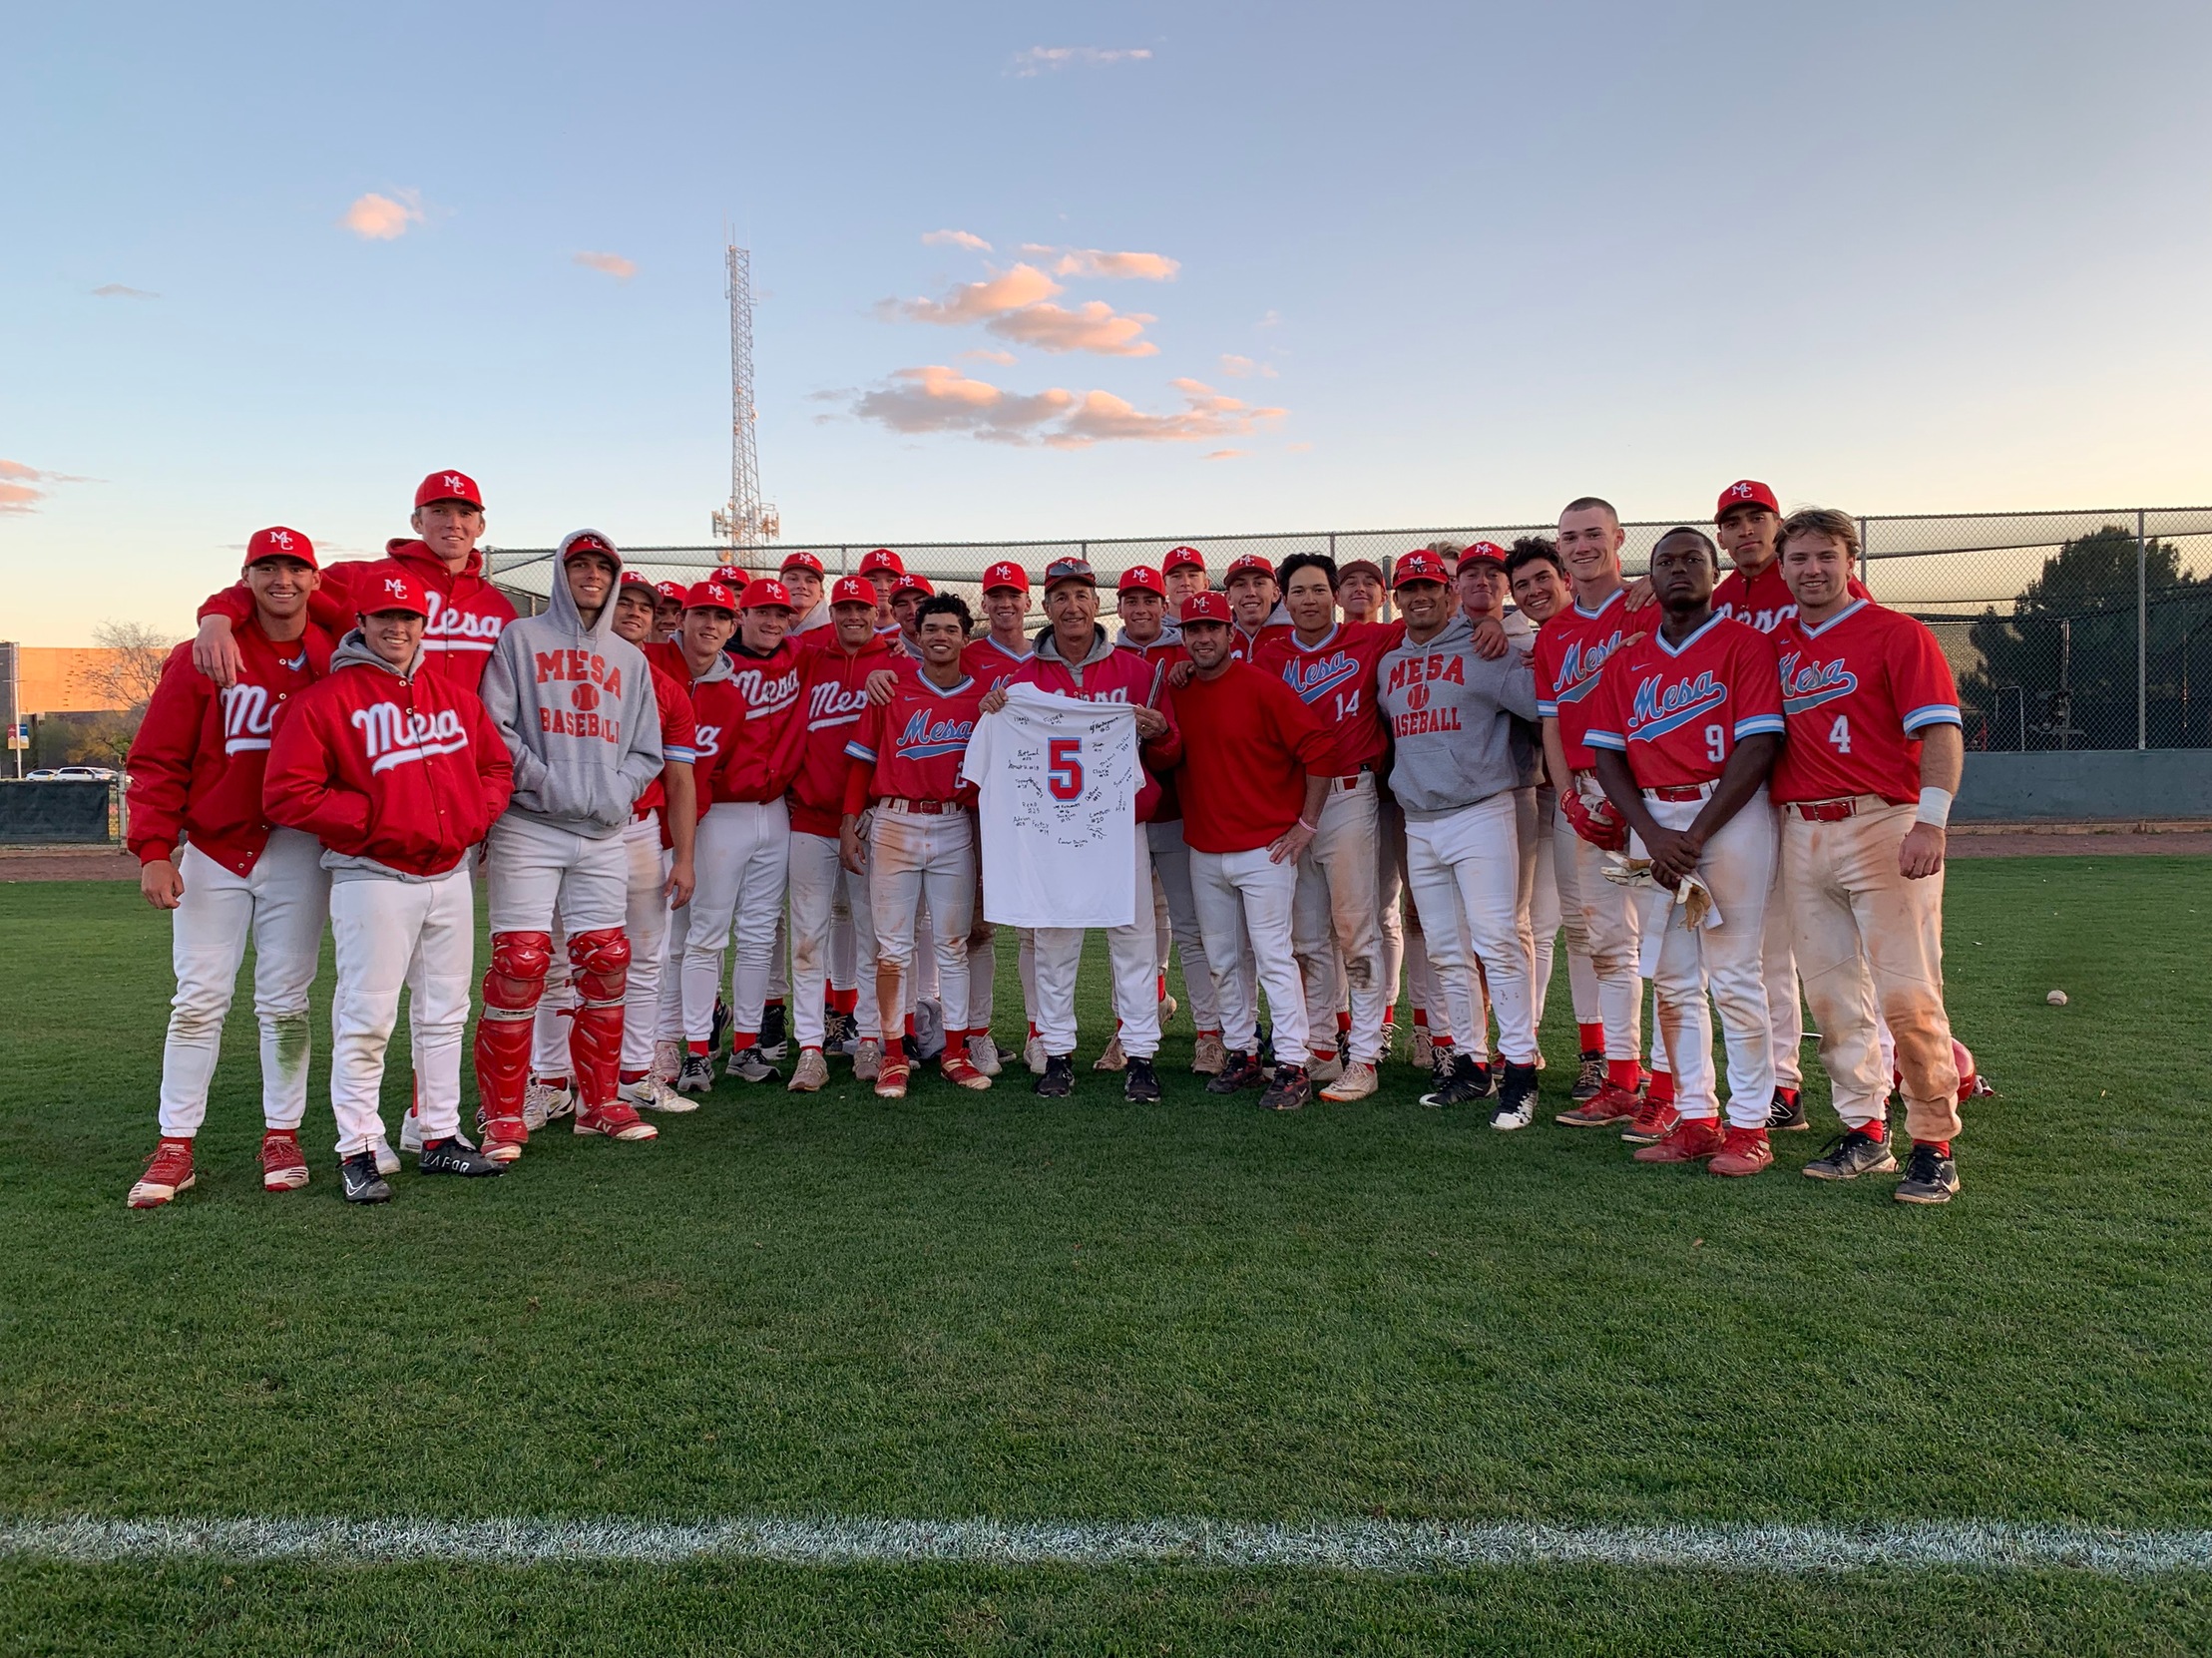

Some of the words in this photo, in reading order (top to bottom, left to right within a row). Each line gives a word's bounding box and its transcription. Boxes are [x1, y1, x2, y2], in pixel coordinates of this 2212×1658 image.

[443, 475, 465, 495] MC
[1731, 482, 1753, 499] MC
[270, 531, 293, 551] MC
[876, 553, 890, 567] MC
[1176, 549, 1191, 561] MC
[1239, 555, 1255, 567] MC
[721, 567, 736, 579] MC
[899, 575, 914, 587] MC
[996, 565, 1012, 581] MC
[1132, 569, 1148, 583] MC
[384, 579, 407, 600] MC
[658, 584, 674, 597] MC
[708, 585, 724, 602] MC
[766, 583, 782, 600] MC
[844, 580, 858, 595] MC
[1192, 597, 1209, 613] MC
[535, 648, 622, 701] MESA
[1386, 653, 1466, 697] MESA
[808, 680, 869, 719] Mes
[1335, 688, 1360, 722] 14
[1627, 669, 1716, 727] Mesa
[351, 701, 467, 758] Mesa
[896, 707, 973, 746] Mesa
[1829, 714, 1852, 753] 4
[1704, 724, 1725, 763] 9
[1048, 737, 1085, 802] 5
